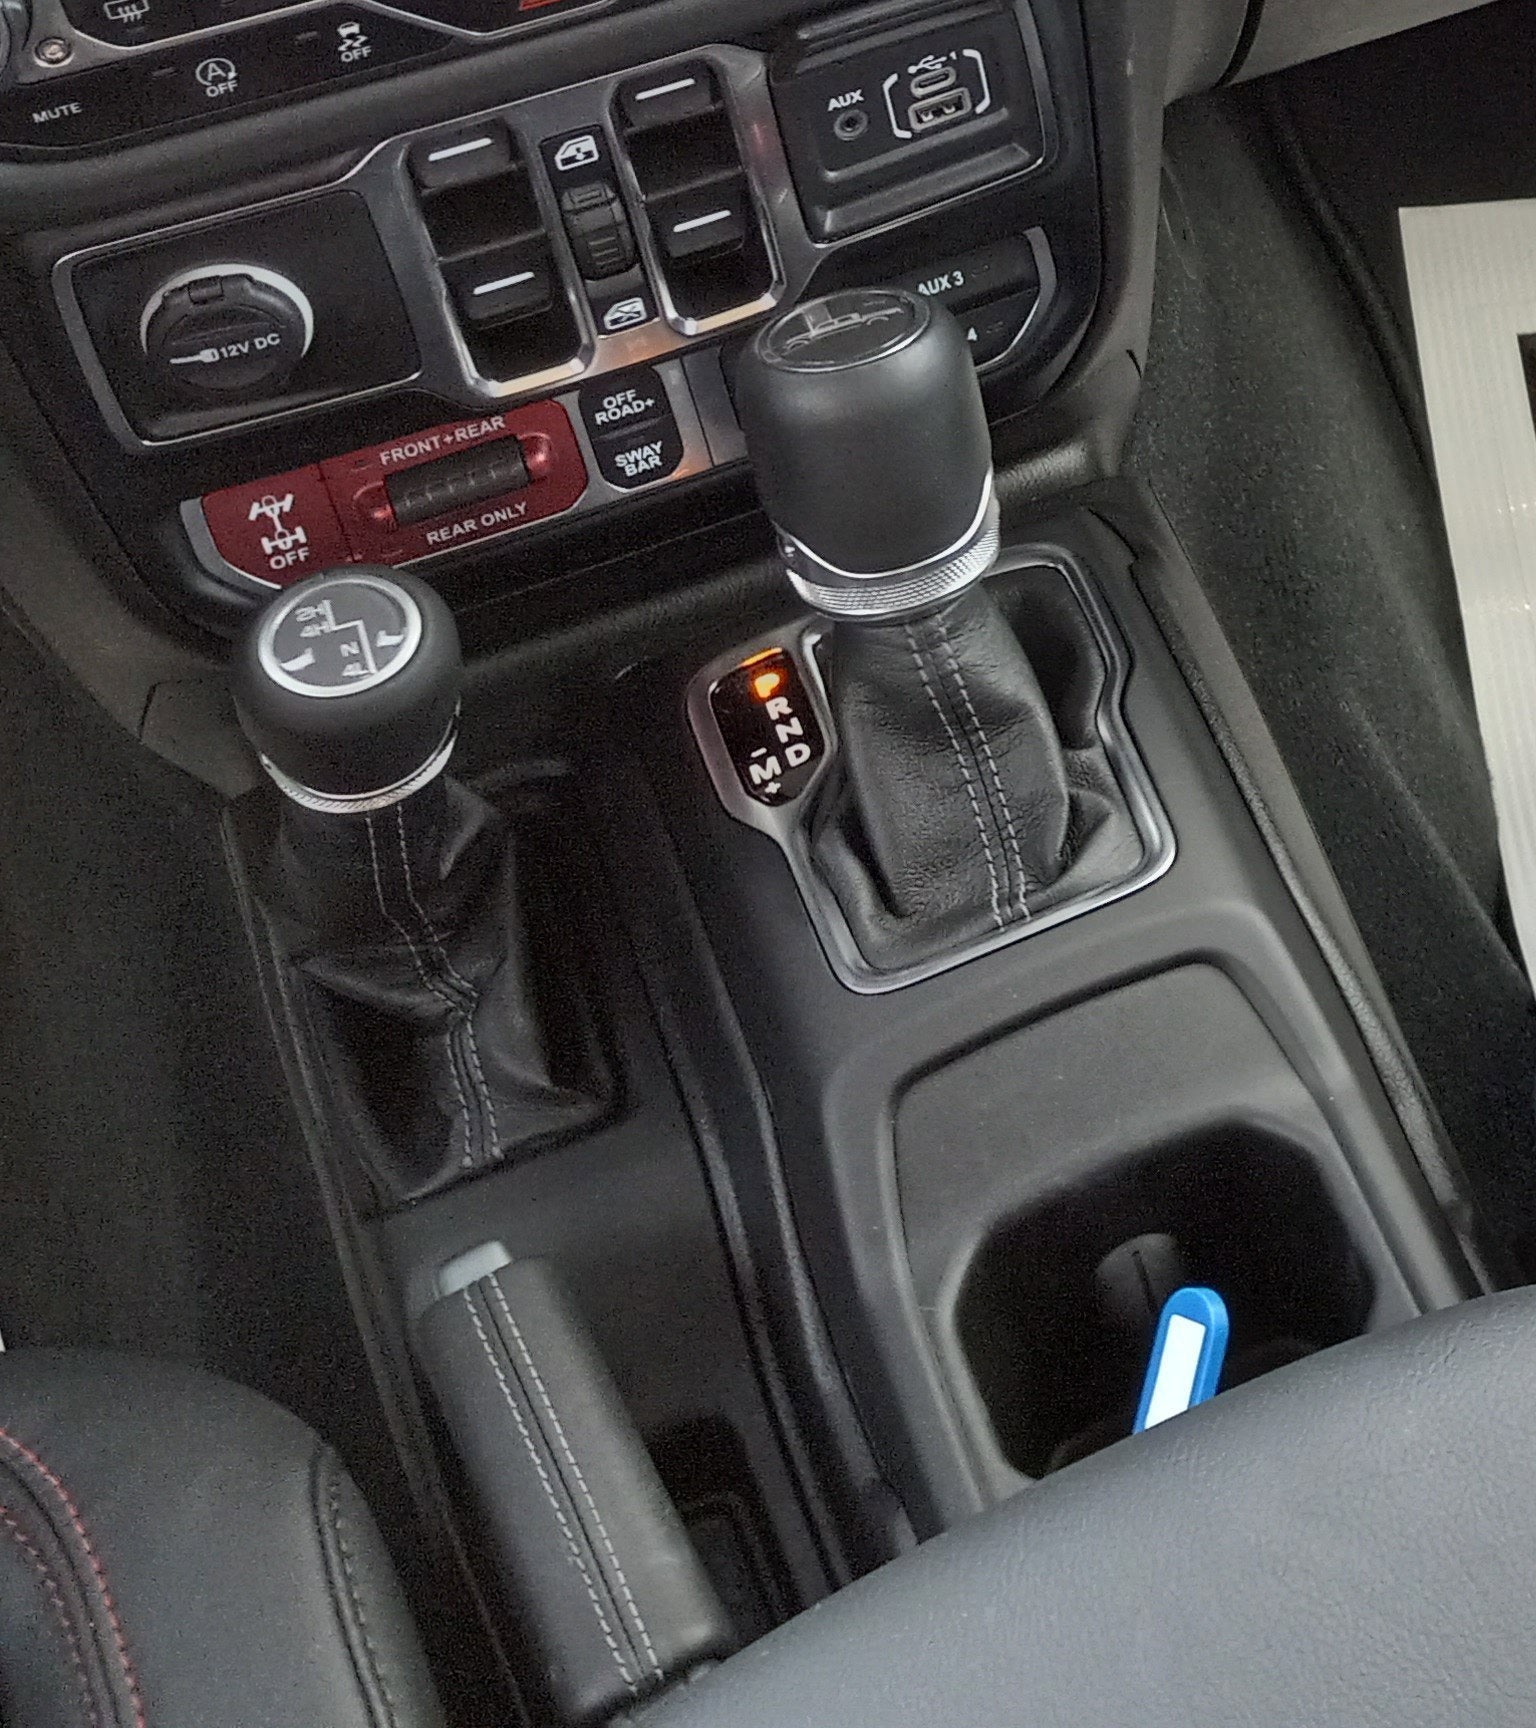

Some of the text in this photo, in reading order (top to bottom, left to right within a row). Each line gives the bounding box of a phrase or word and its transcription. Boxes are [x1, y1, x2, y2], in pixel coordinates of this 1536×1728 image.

[340, 45, 373, 63] OFF
[205, 80, 239, 99] OFF
[827, 88, 865, 112] AUX
[32, 101, 83, 124] MUTE
[219, 332, 281, 359] 12V DC
[594, 397, 656, 426] ROAD+
[603, 389, 637, 411] OFF
[614, 440, 664, 467] SWAY
[624, 454, 664, 478] BAR
[426, 501, 530, 546] REAR ONLY
[269, 546, 310, 570] OFF
